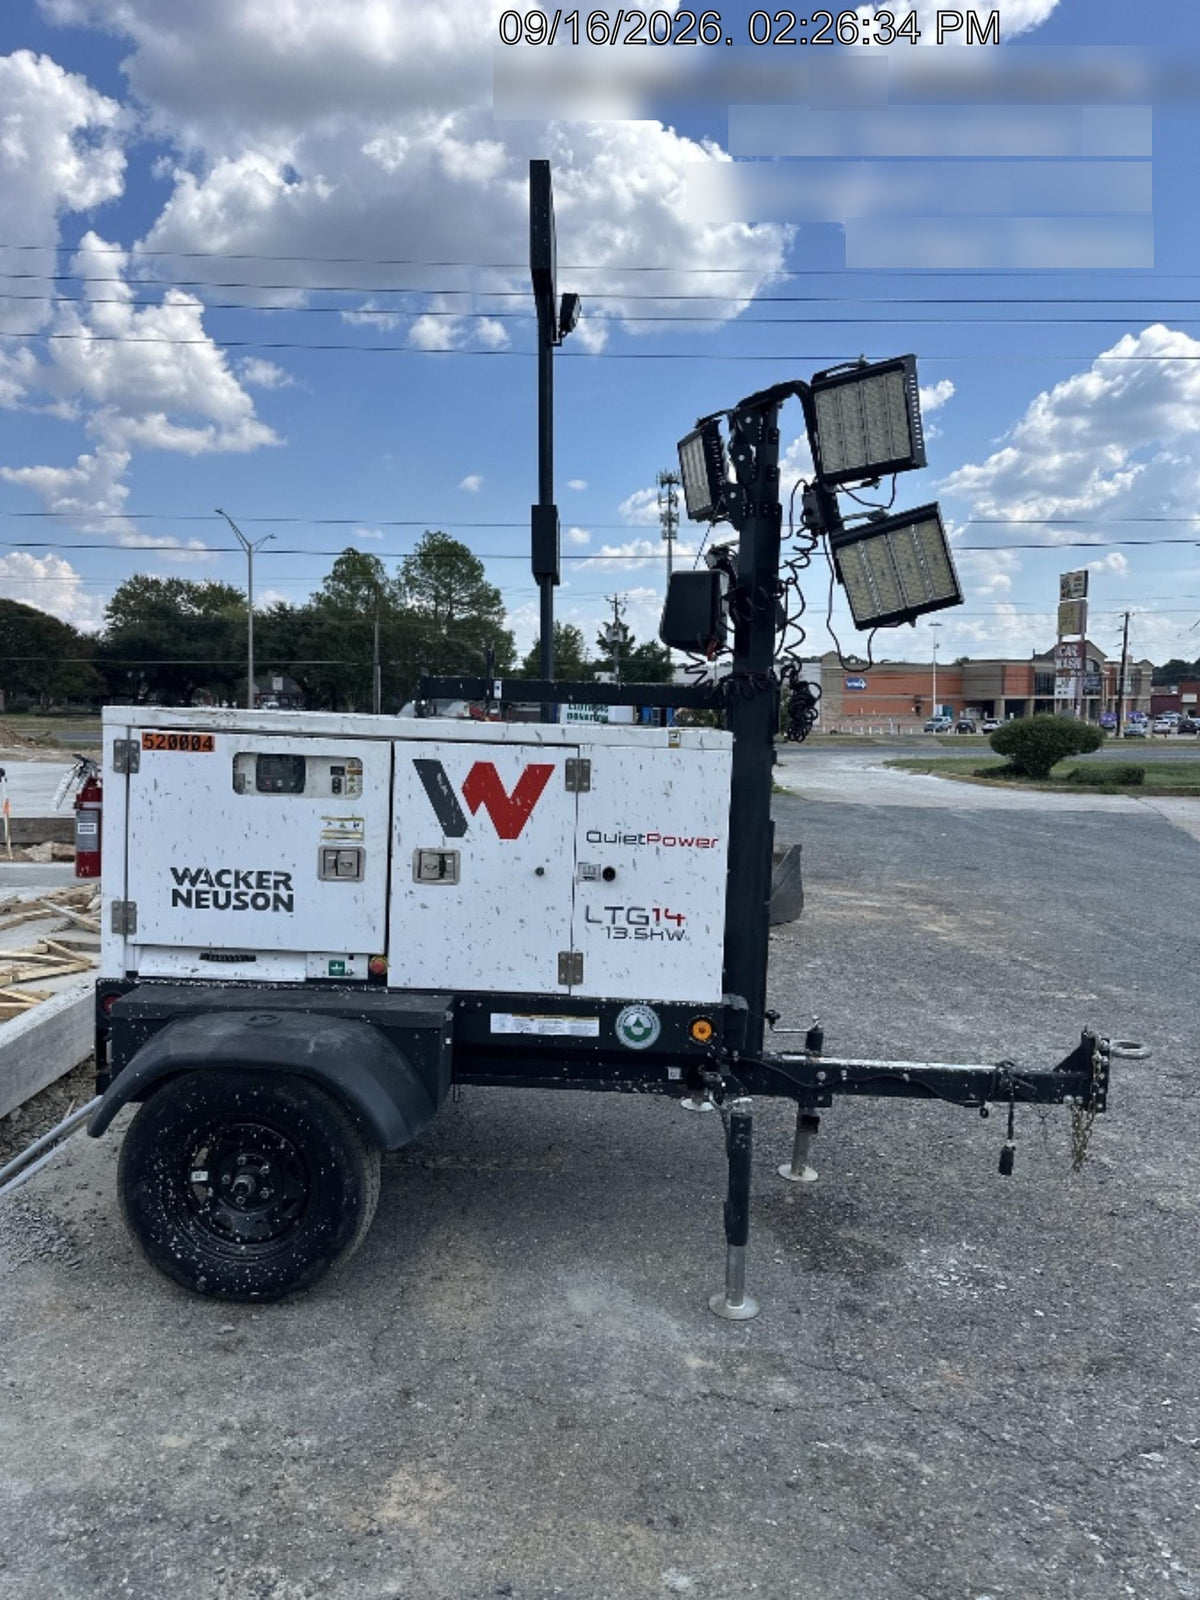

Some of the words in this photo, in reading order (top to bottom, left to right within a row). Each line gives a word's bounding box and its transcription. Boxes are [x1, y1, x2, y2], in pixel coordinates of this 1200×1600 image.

[143, 733, 214, 751] 520004
[586, 830, 719, 848] QuietPower
[170, 867, 293, 891] WACKER
[171, 889, 294, 912] NEUSON
[585, 905, 686, 927] LTG14
